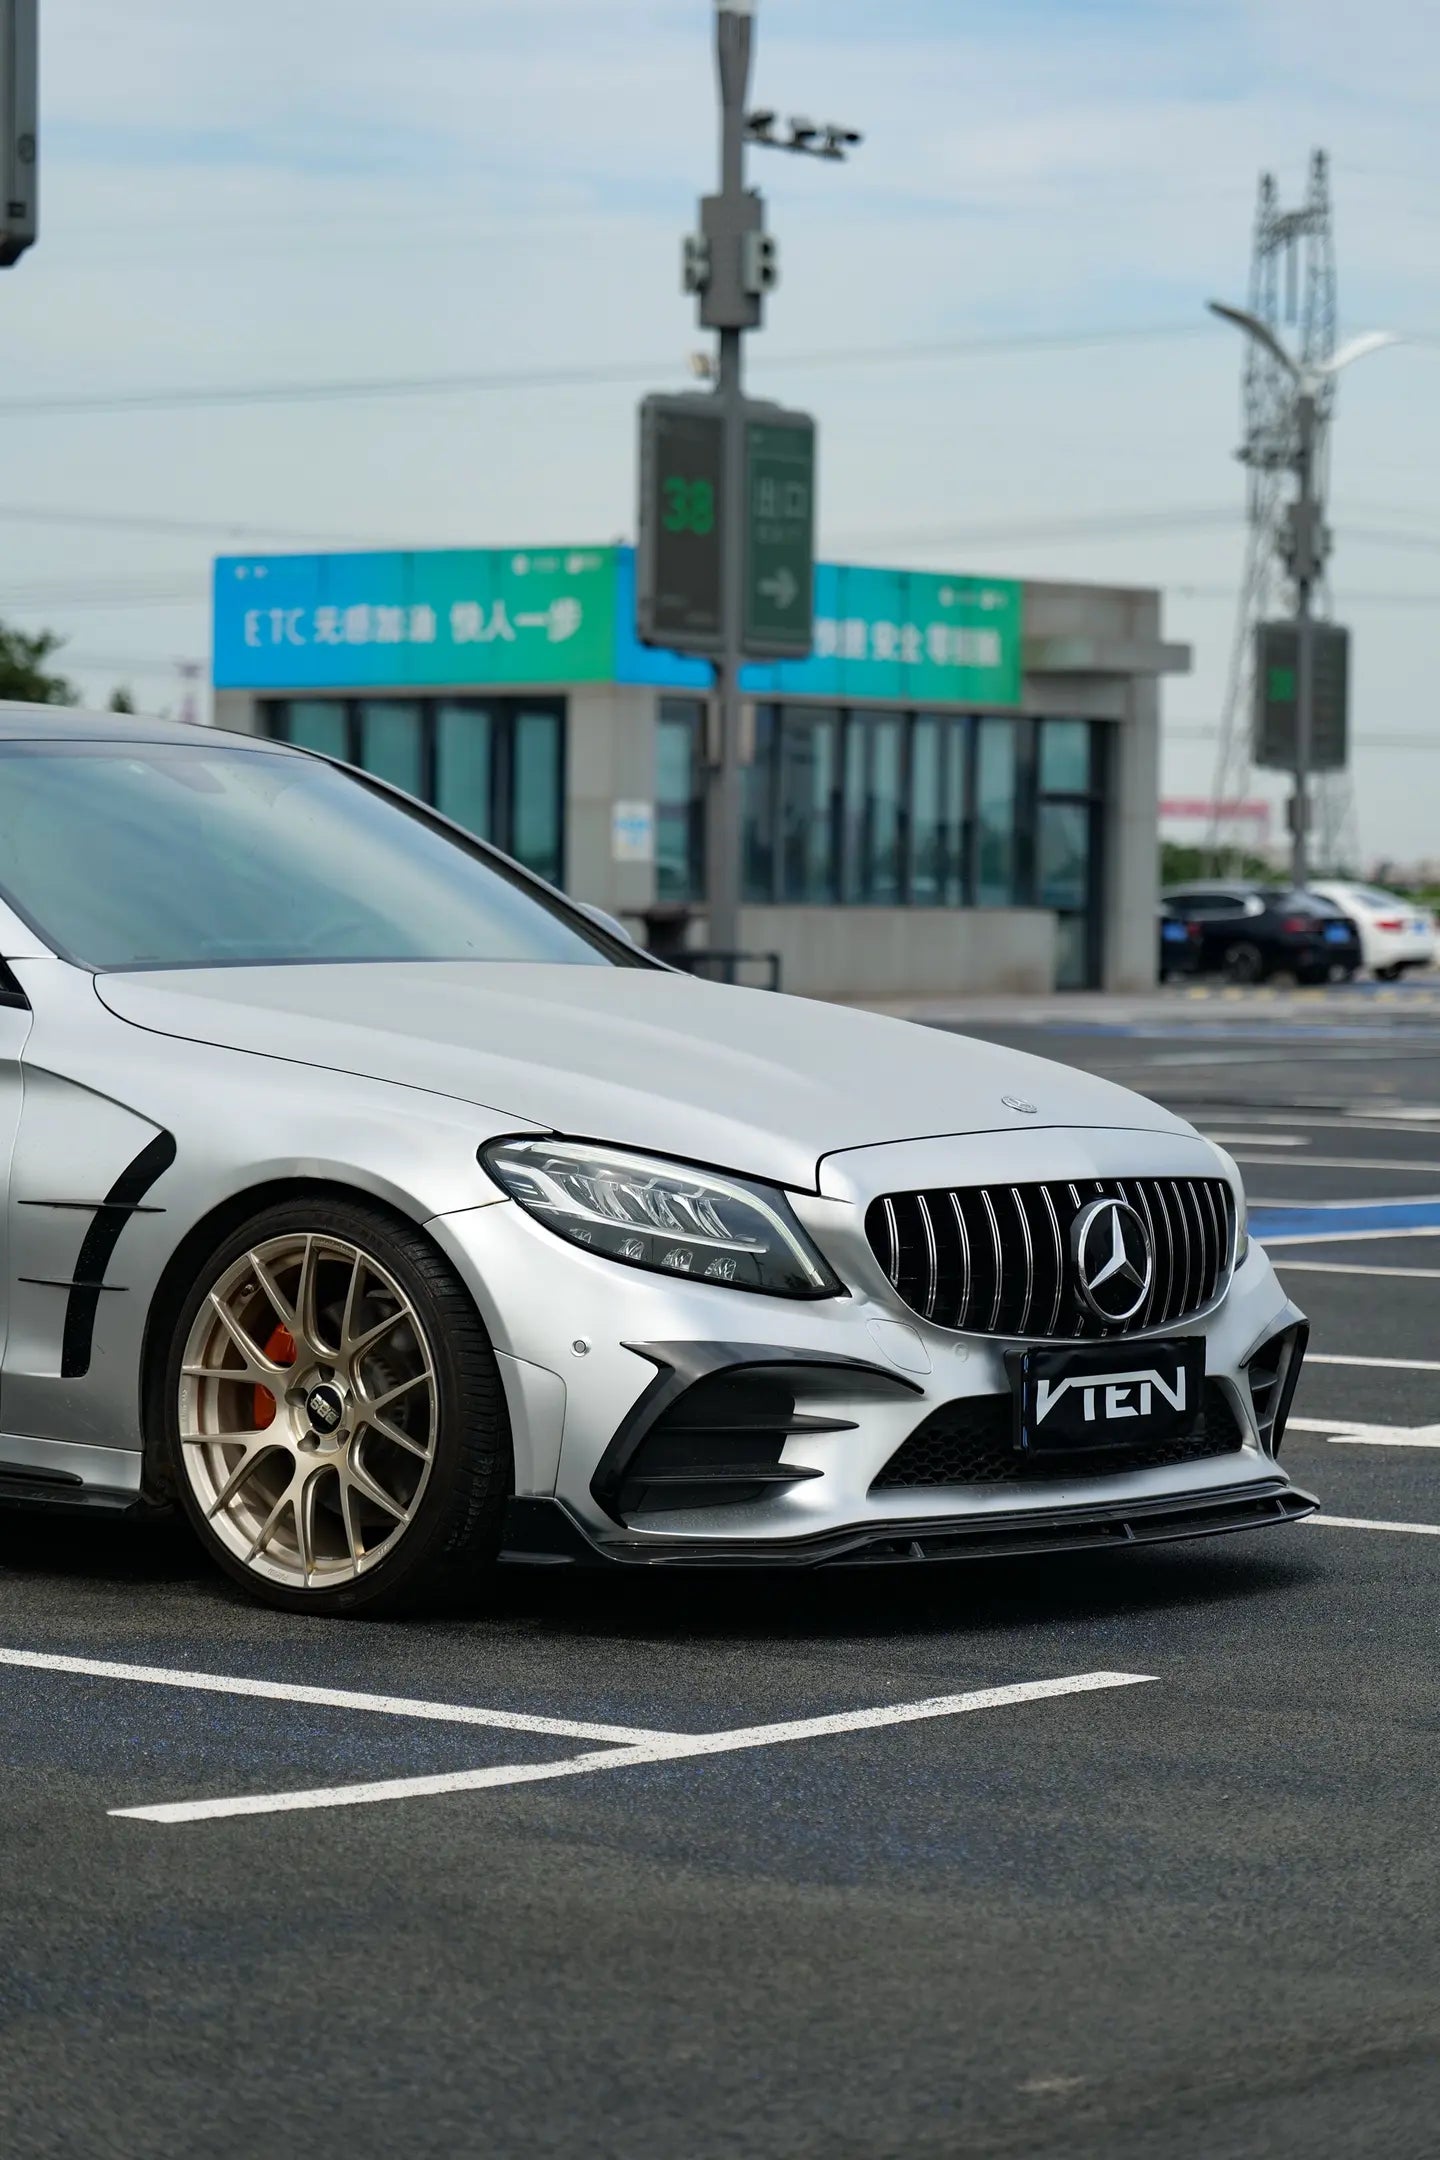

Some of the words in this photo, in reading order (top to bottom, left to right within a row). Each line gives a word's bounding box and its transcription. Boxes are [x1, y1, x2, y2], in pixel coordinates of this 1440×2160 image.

[662, 476, 714, 535] 38
[244, 608, 306, 647] ETC
[450, 598, 583, 643] 快人一步
[1036, 1366, 1187, 1426] VTEN
